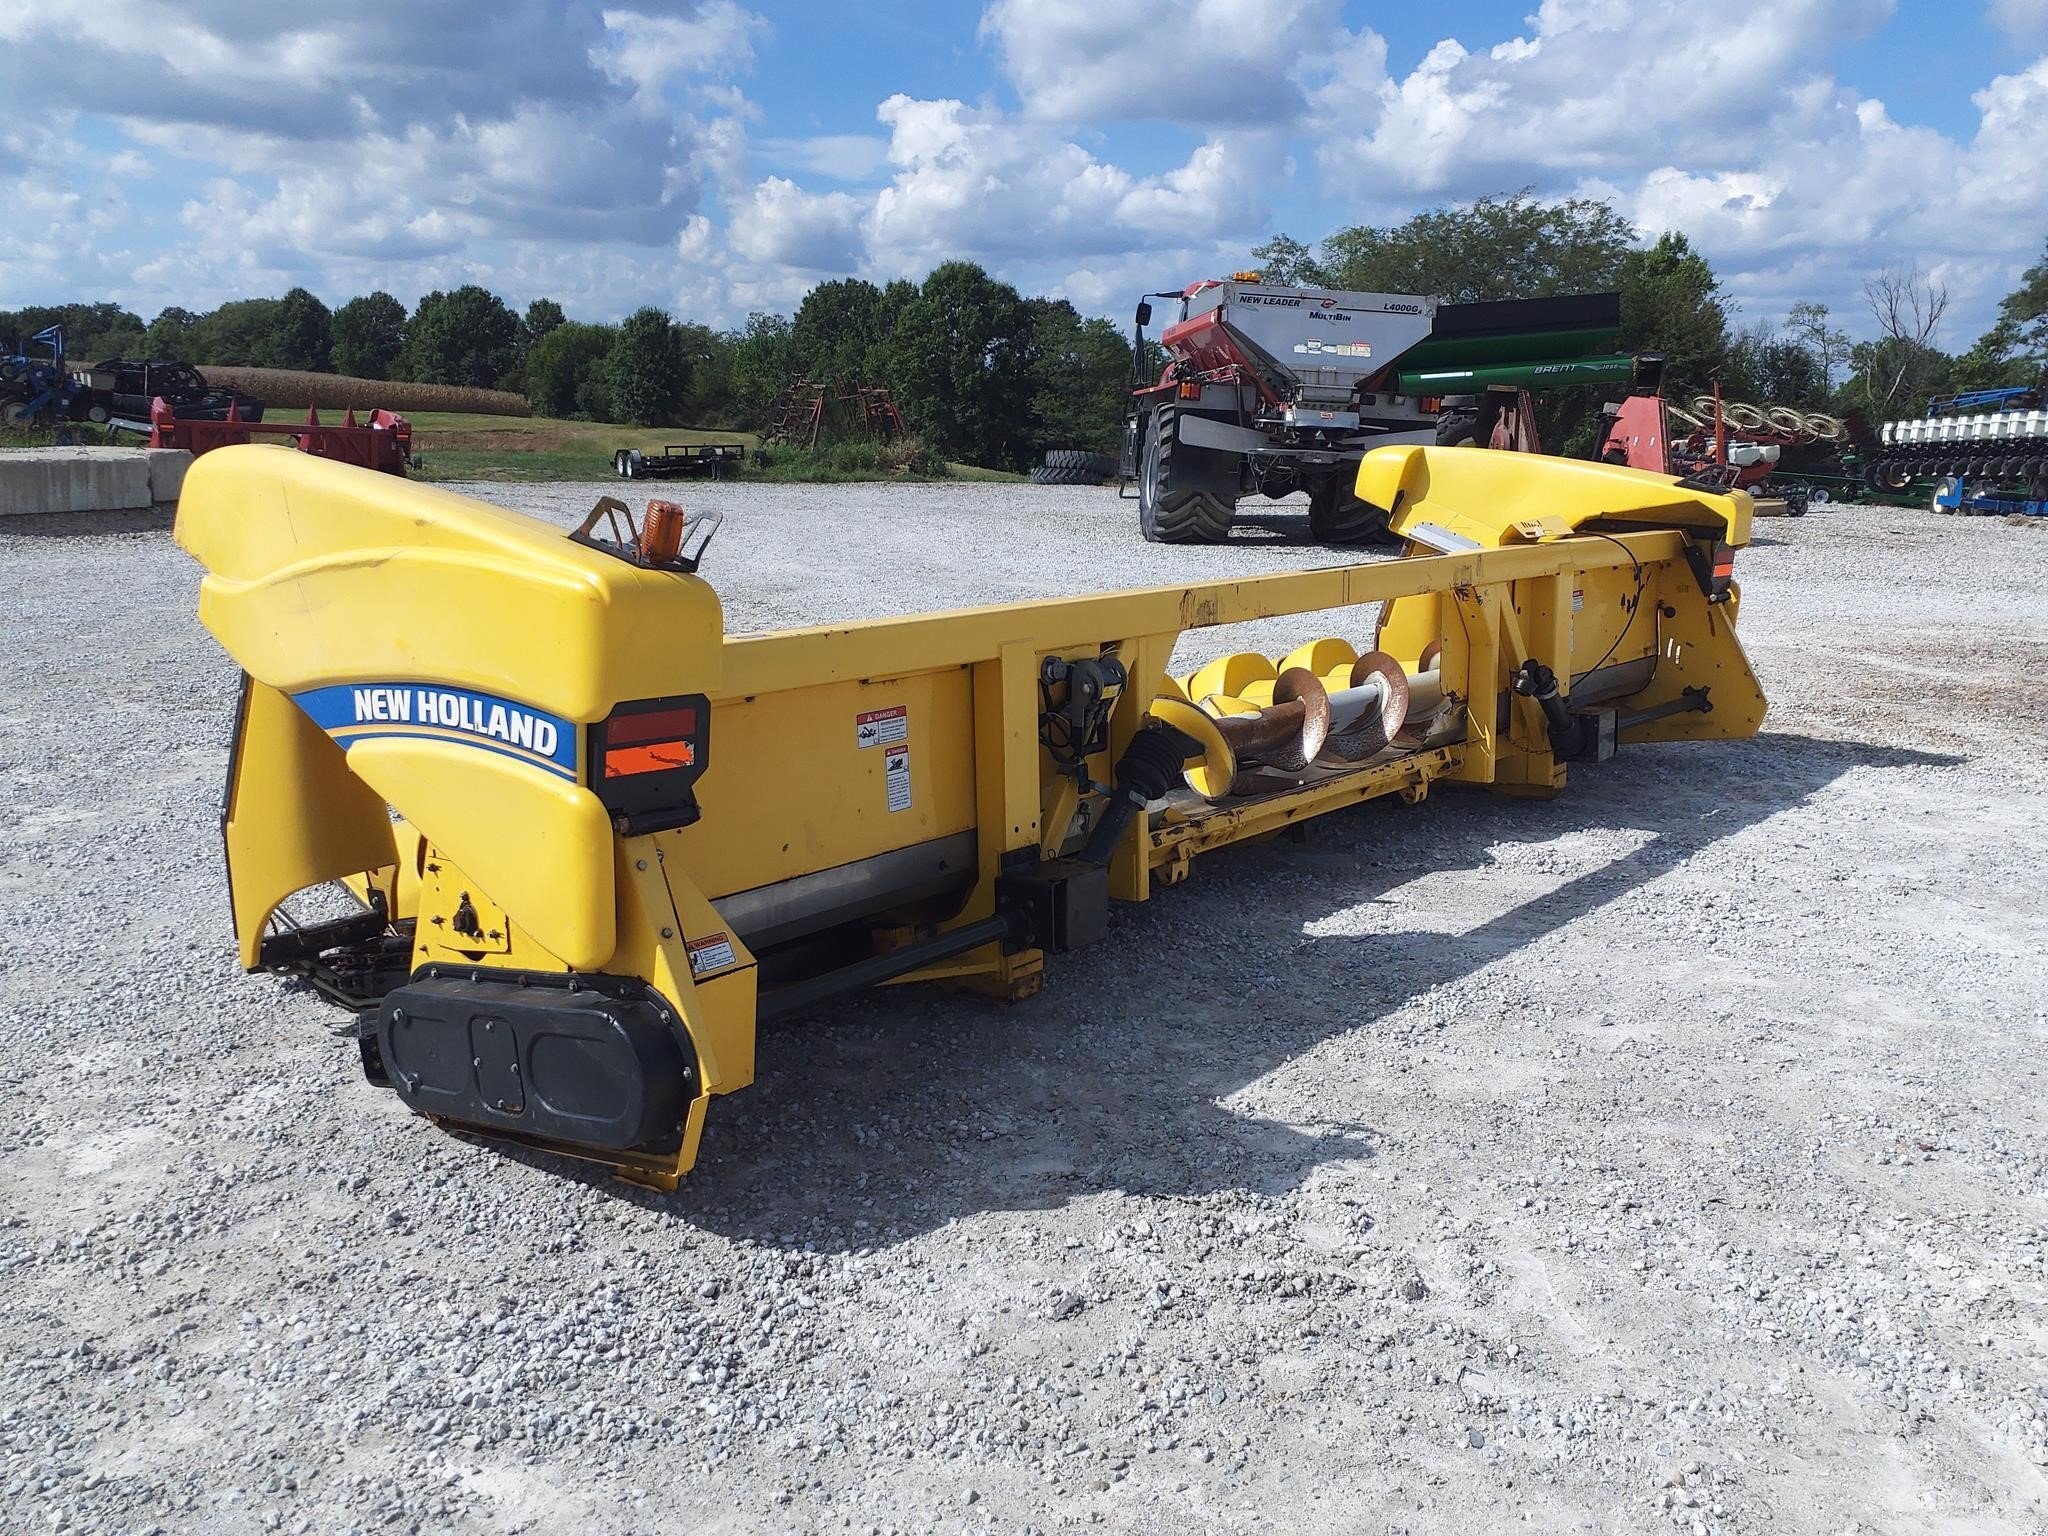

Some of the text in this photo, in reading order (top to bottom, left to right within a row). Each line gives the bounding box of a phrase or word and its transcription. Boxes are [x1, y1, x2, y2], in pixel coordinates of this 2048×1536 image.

[1239, 296, 1301, 308] NEW LEADER
[1534, 364, 1576, 374] BRENT
[874, 710, 898, 720] DANGER
[353, 689, 558, 757] NEW HOLLAND
[694, 935, 724, 947] WARNING
